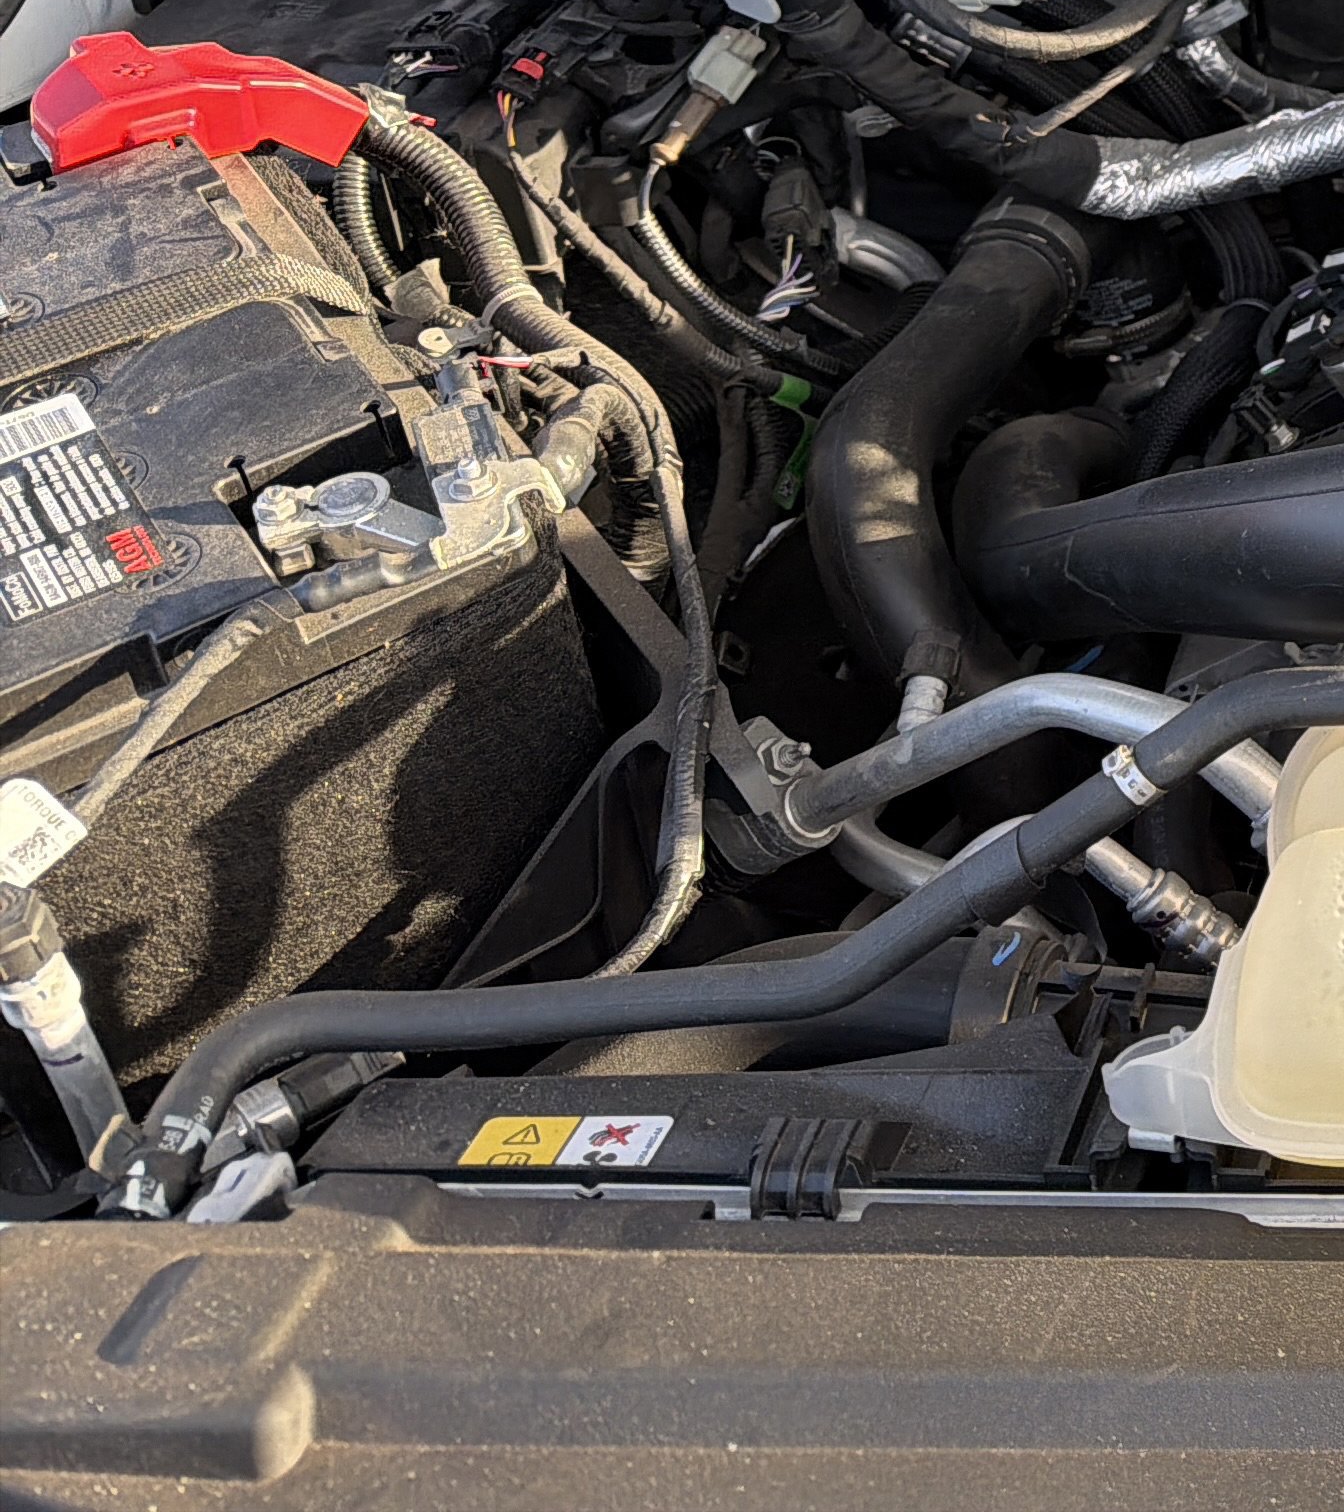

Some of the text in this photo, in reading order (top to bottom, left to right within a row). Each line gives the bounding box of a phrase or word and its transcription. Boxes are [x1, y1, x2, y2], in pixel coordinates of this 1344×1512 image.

[106, 527, 152, 574] AGM
[4, 576, 34, 620] FoMoCo
[17, 785, 67, 830] TORQUE
[194, 1095, 215, 1124] RAD
